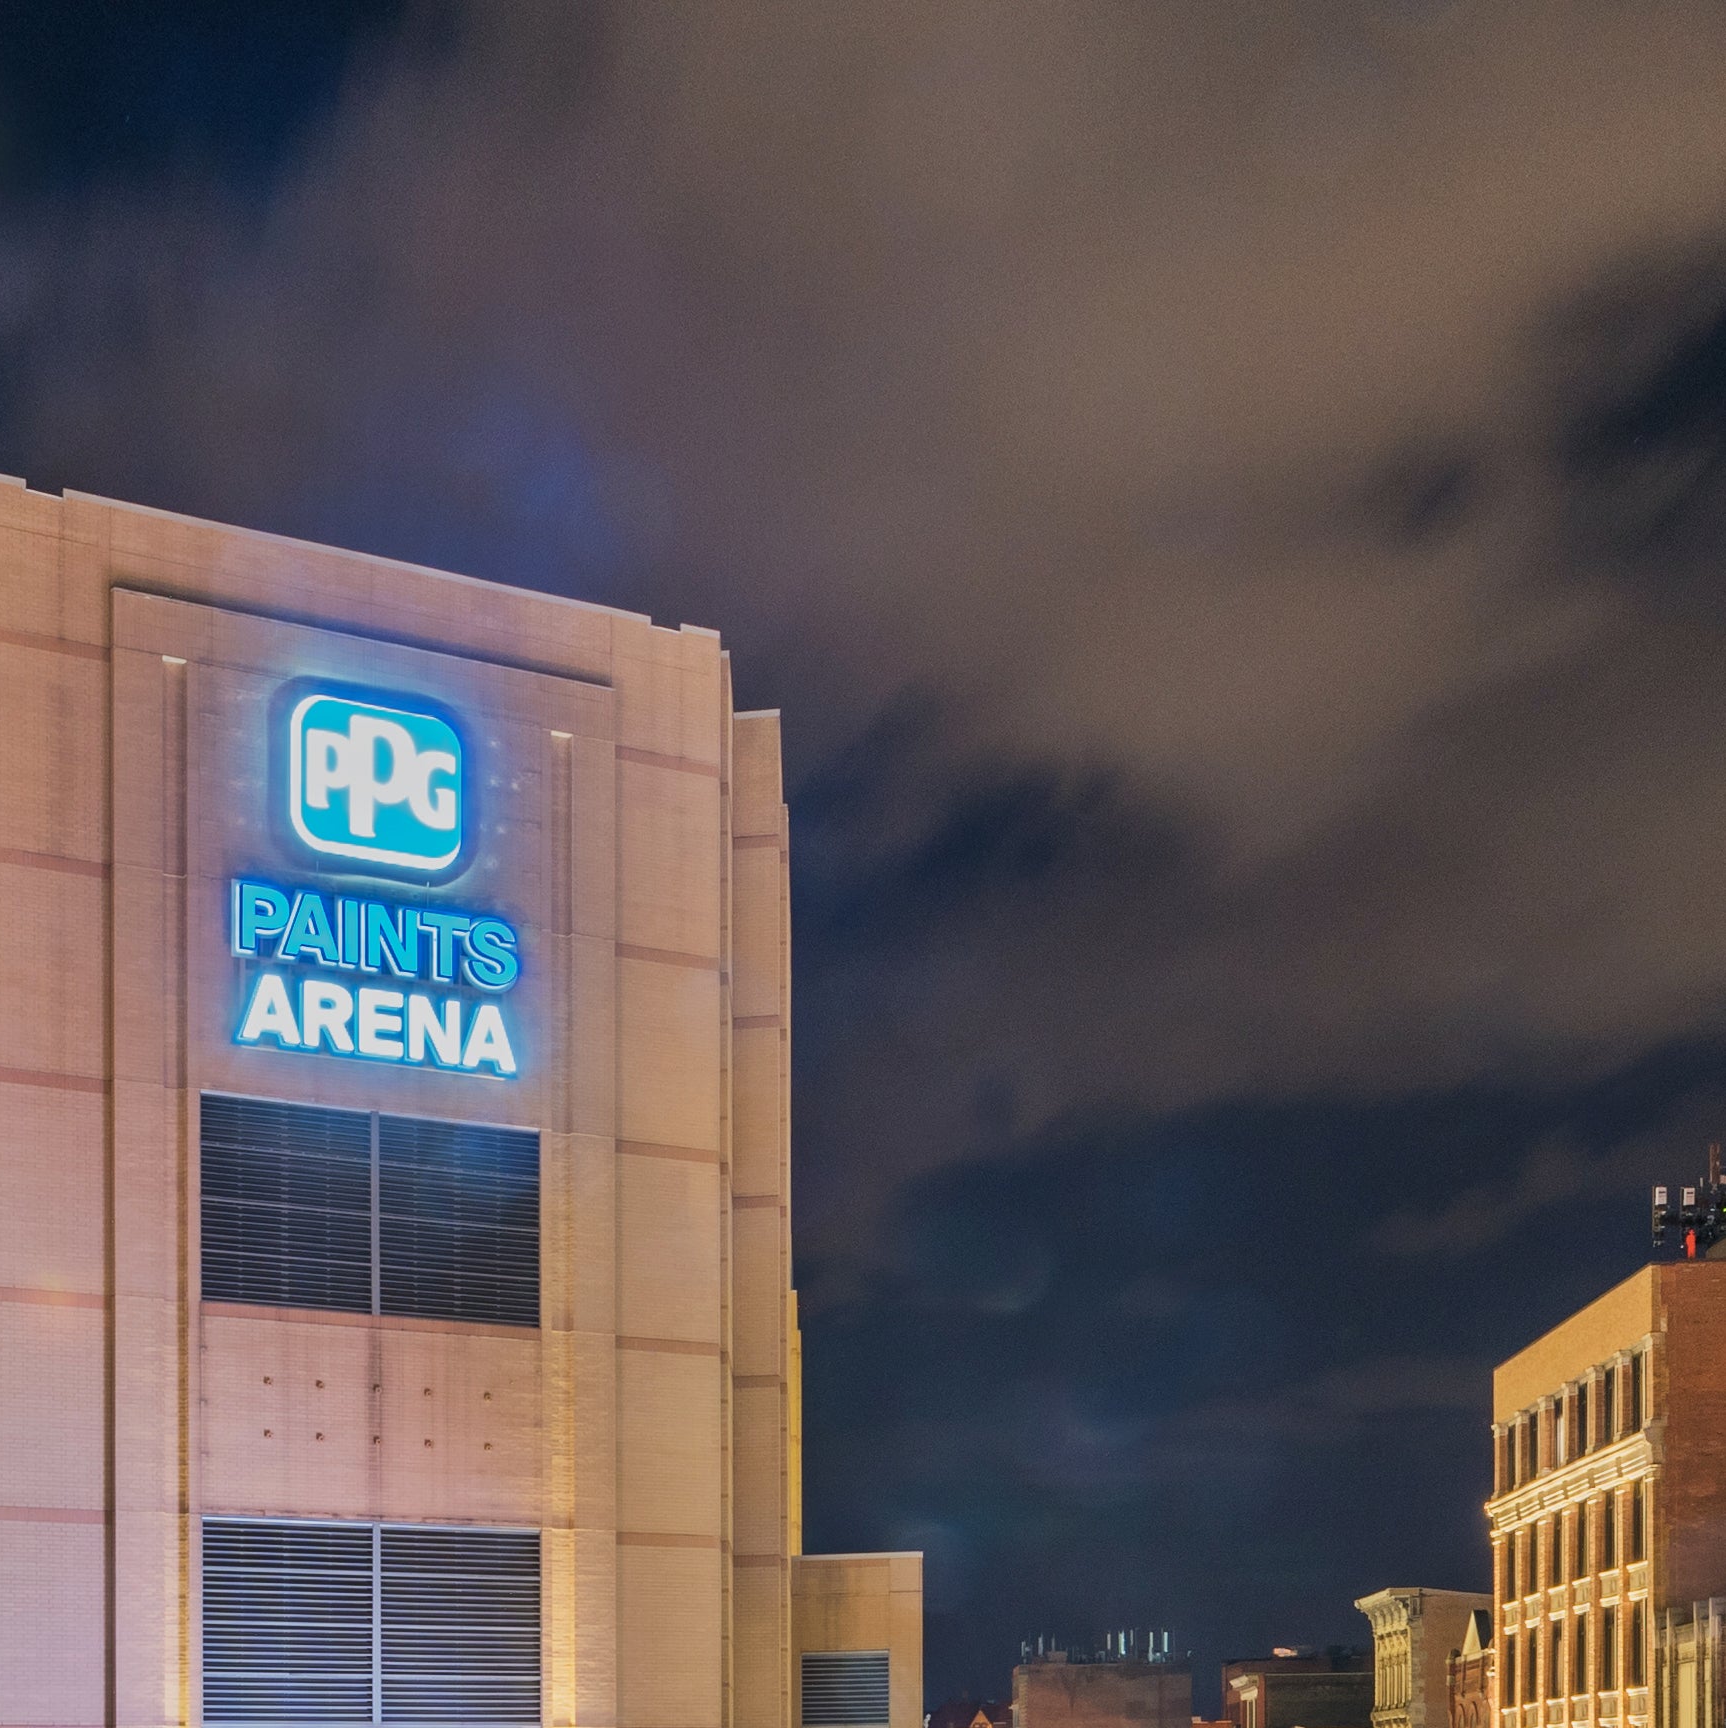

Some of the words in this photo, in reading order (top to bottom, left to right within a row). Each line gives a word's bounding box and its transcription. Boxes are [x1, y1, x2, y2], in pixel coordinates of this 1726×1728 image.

[305, 713, 457, 839] PPG
[236, 883, 519, 991] PAINTS
[238, 973, 517, 1073] ARENA
